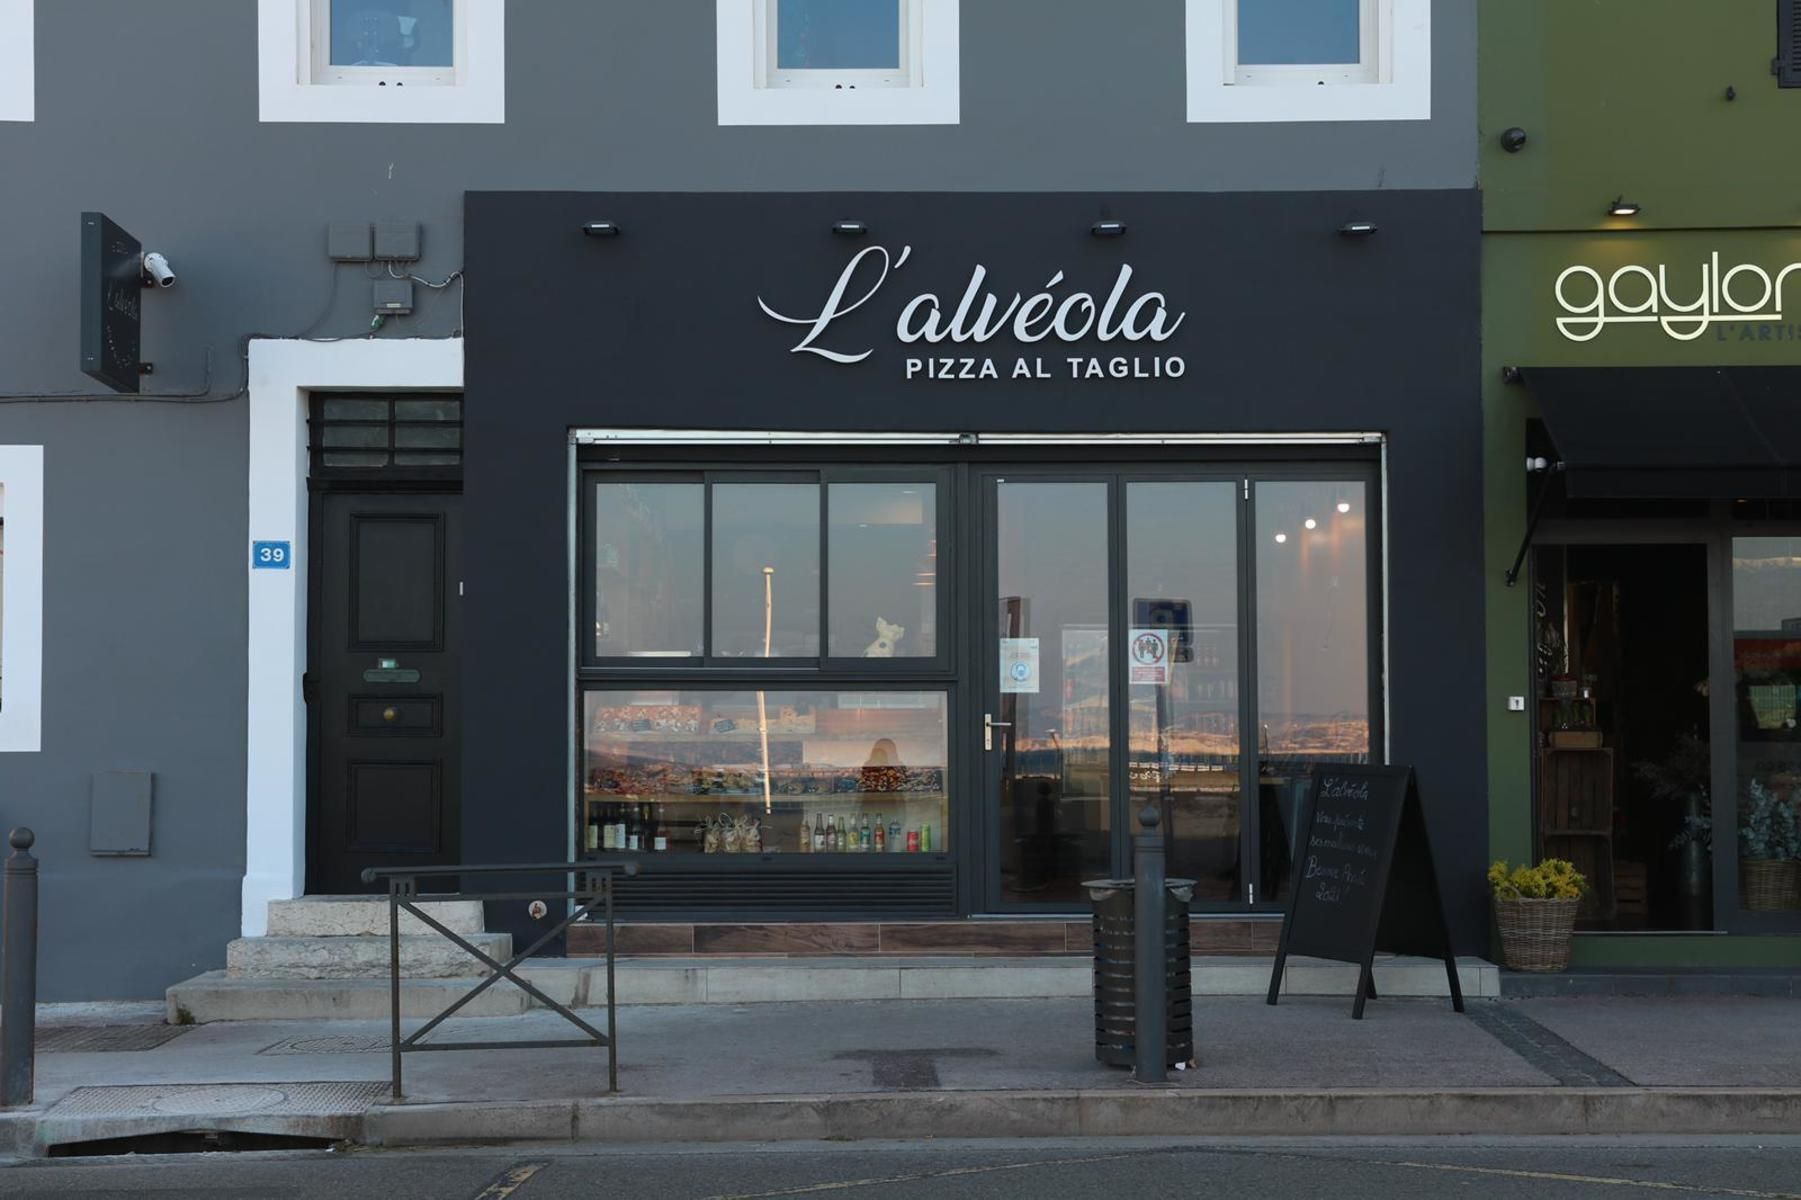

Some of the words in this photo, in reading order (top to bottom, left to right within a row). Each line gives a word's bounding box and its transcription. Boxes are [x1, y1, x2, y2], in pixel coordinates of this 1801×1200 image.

[757, 245, 1186, 364] L'alvéola
[906, 356, 999, 379] PIZZA
[1012, 356, 1052, 379] AL
[1067, 356, 1186, 379] TAGLIO
[260, 547, 285, 562] 39
